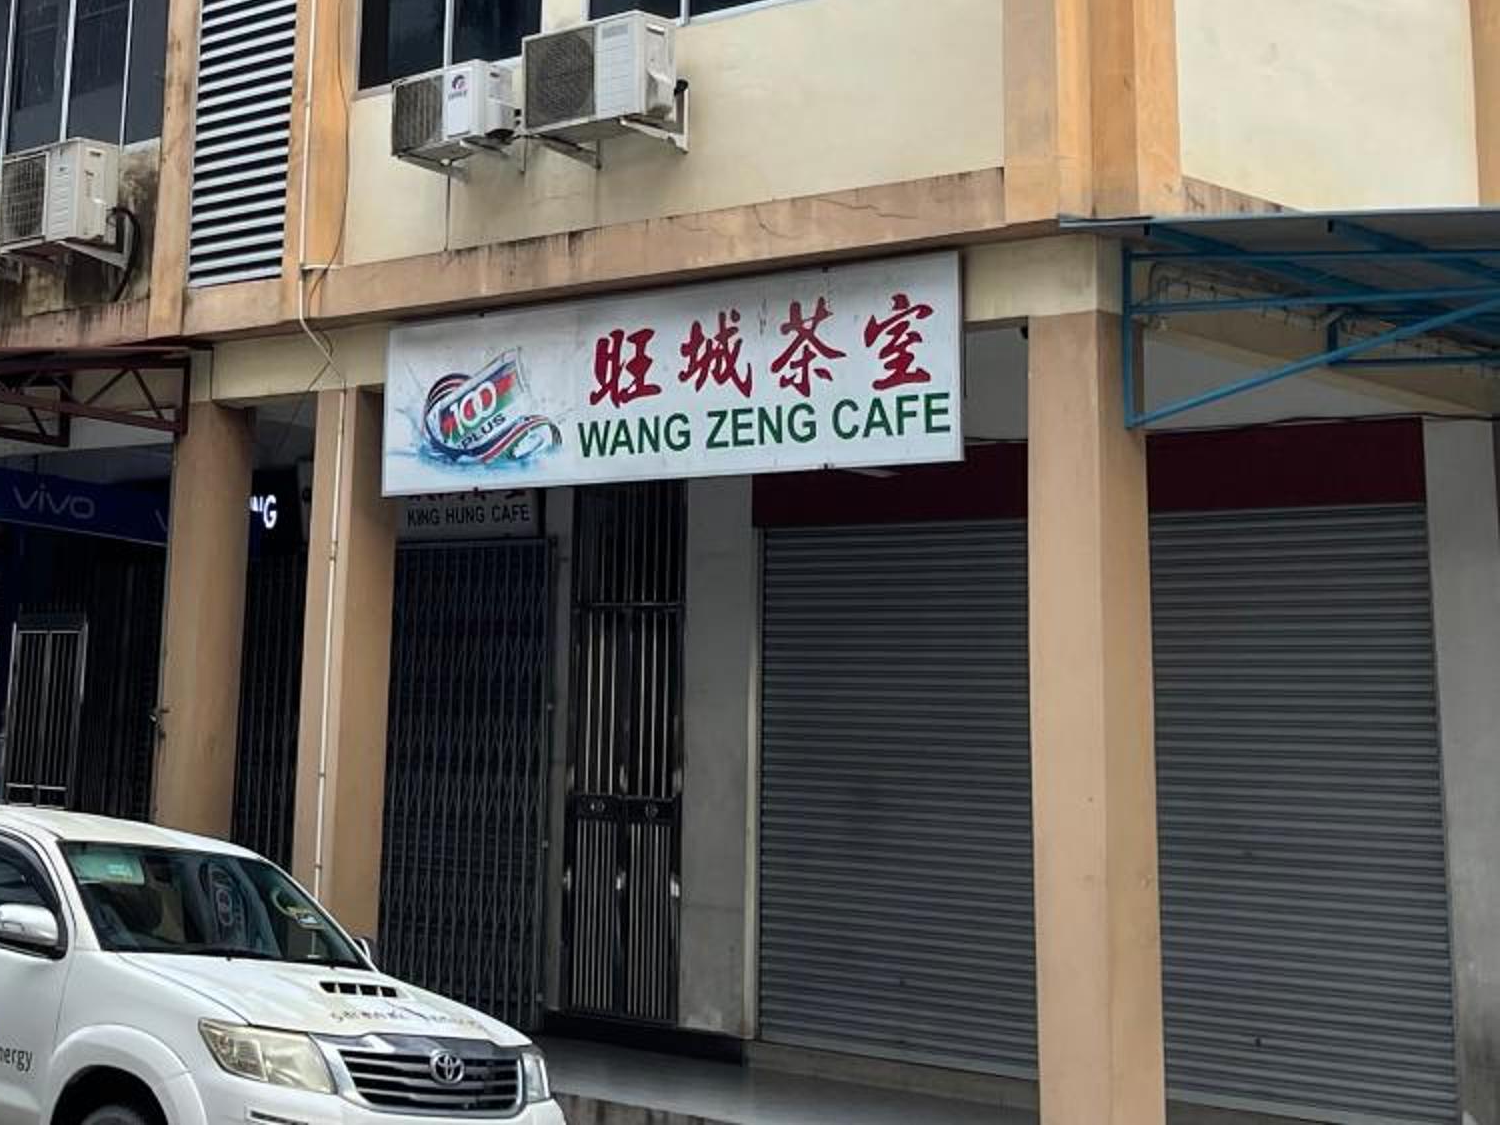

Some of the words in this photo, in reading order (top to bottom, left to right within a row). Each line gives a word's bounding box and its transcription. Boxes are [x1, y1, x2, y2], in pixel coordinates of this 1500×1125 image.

[589, 293, 934, 408] 旺城茶室
[449, 380, 497, 435] 100
[578, 412, 692, 458] WANG
[705, 402, 818, 449] ZENG
[831, 392, 952, 441] CAFE
[459, 415, 507, 450] PLUS
[13, 483, 96, 519] vivo
[445, 505, 485, 524] HUNG
[491, 503, 531, 523] CAFE
